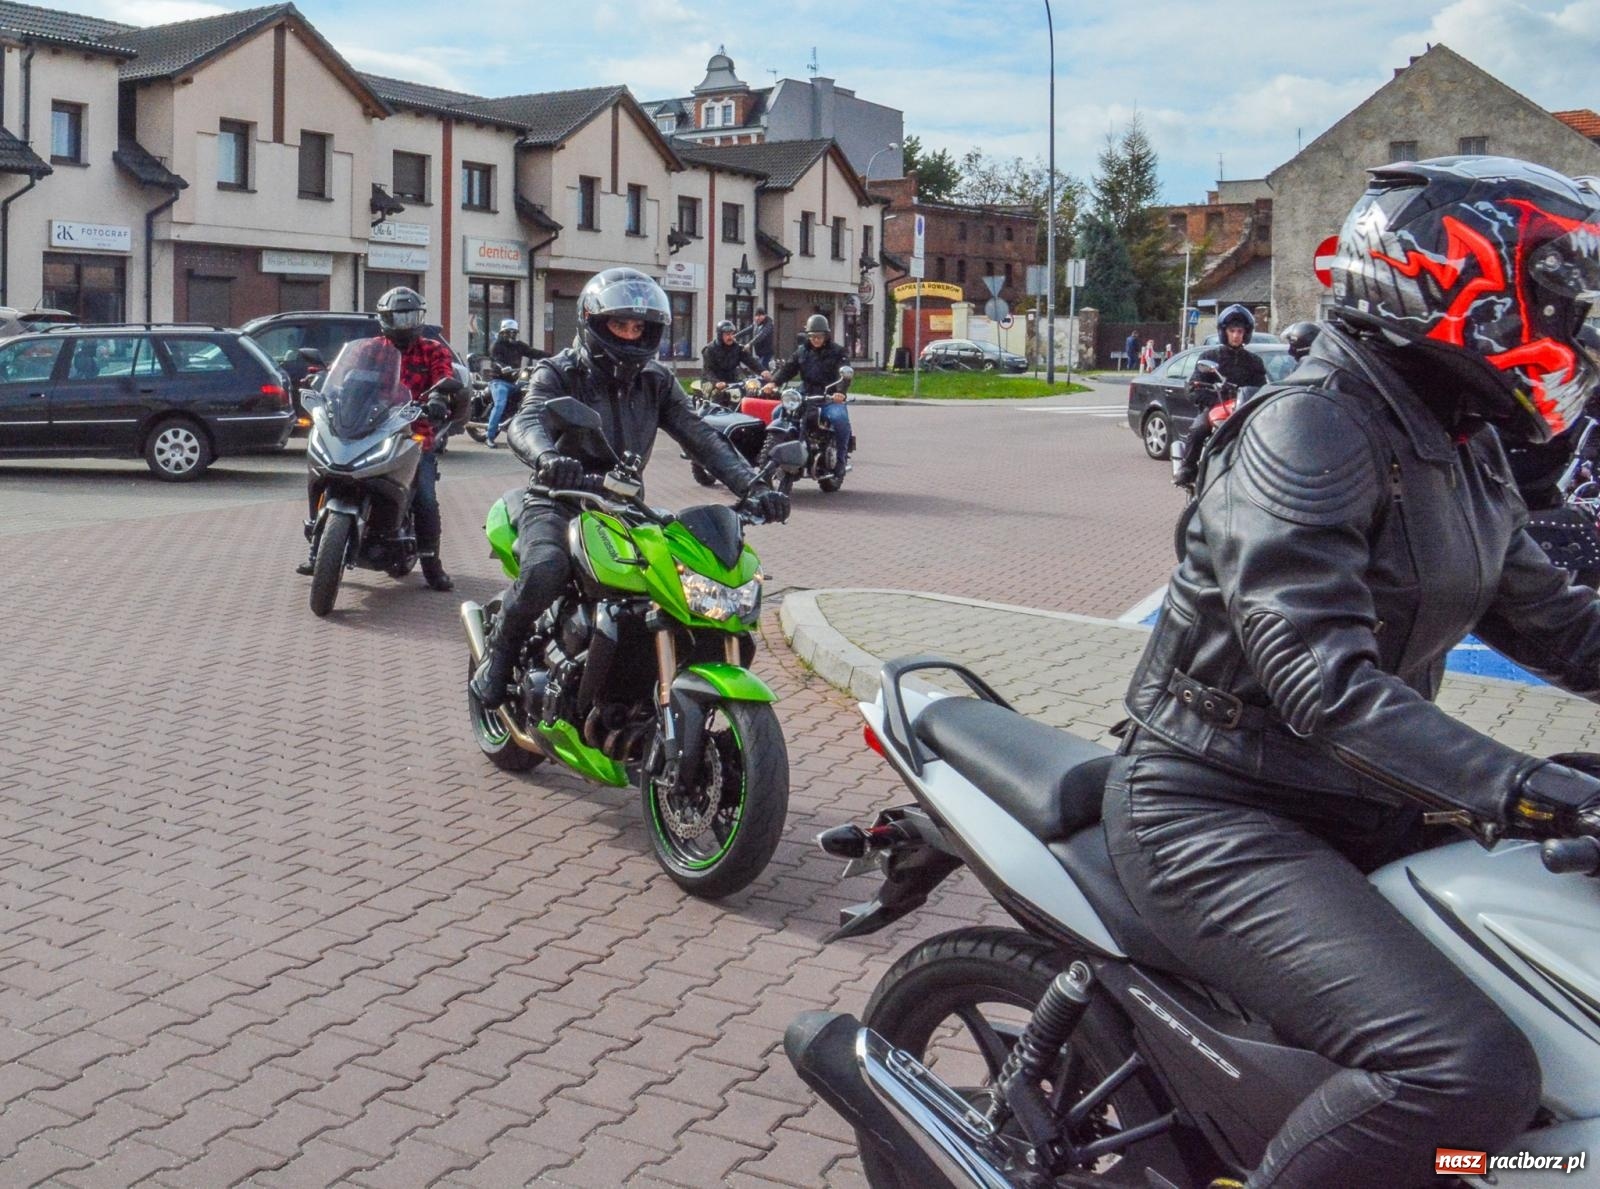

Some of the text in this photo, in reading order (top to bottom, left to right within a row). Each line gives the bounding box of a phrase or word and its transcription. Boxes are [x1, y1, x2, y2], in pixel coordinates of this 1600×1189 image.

[81, 228, 128, 237] FOTOGRAF
[479, 241, 519, 260] dentica
[896, 283, 926, 292] NAPRAA
[1128, 987, 1241, 1079] CBF125
